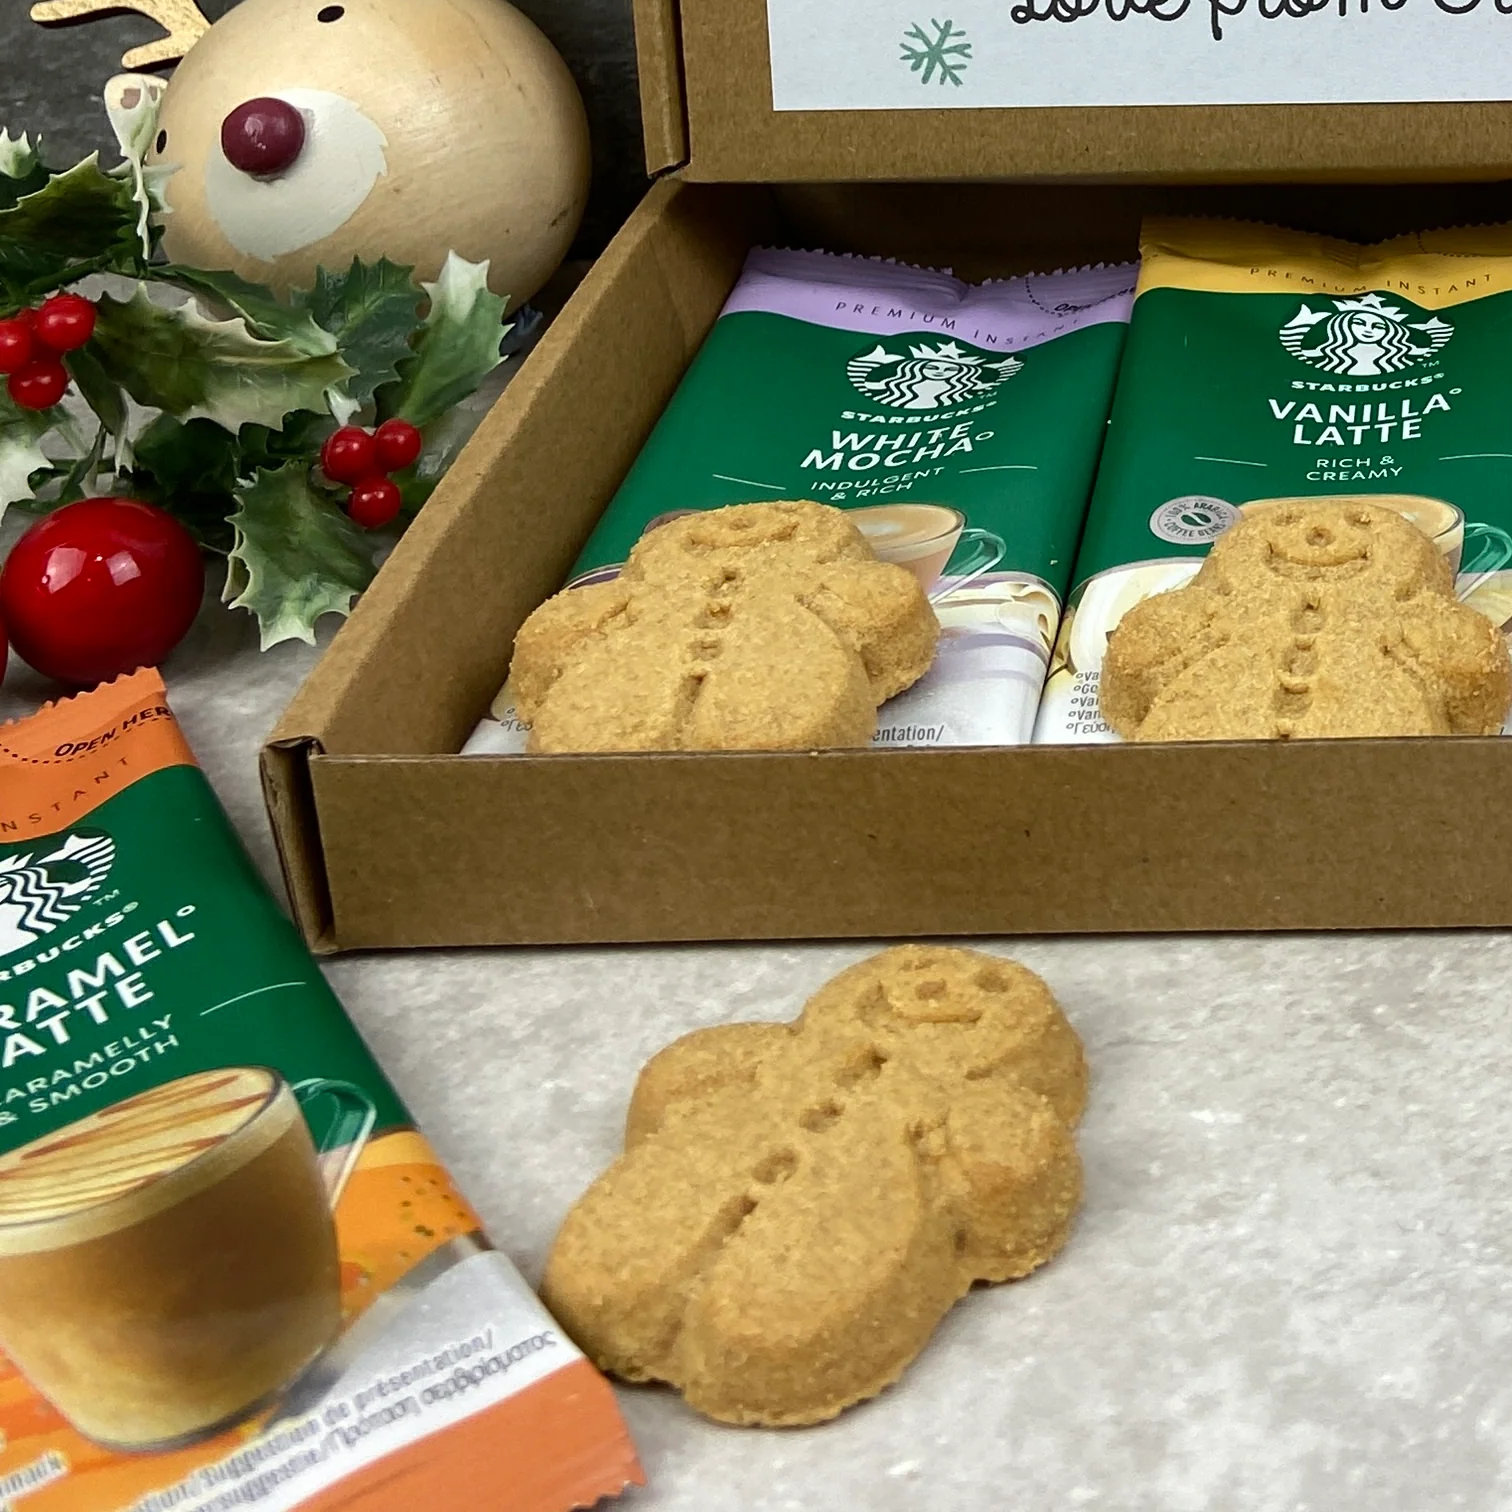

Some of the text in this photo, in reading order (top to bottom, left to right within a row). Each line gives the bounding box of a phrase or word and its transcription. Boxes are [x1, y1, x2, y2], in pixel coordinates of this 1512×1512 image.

[1250, 268, 1491, 295] PREMIUM INSTANT
[836, 301, 956, 330] PREMIUM
[832, 420, 974, 451] WHITE
[1293, 417, 1422, 446] LATTE
[1306, 466, 1404, 481] CREAMY
[1316, 455, 1395, 469] RICH &
[811, 467, 945, 491] INDULGENT
[856, 482, 913, 498] RICH
[54, 706, 173, 757] OPEN HER
[872, 724, 945, 742] entation/
[0, 756, 129, 833] NSTANT
[0, 904, 196, 1030] RAMEL°
[2, 971, 155, 1068] ATTE
[0, 1013, 172, 1106] ARAMELLY
[28, 1034, 179, 1113] SMOOTH
